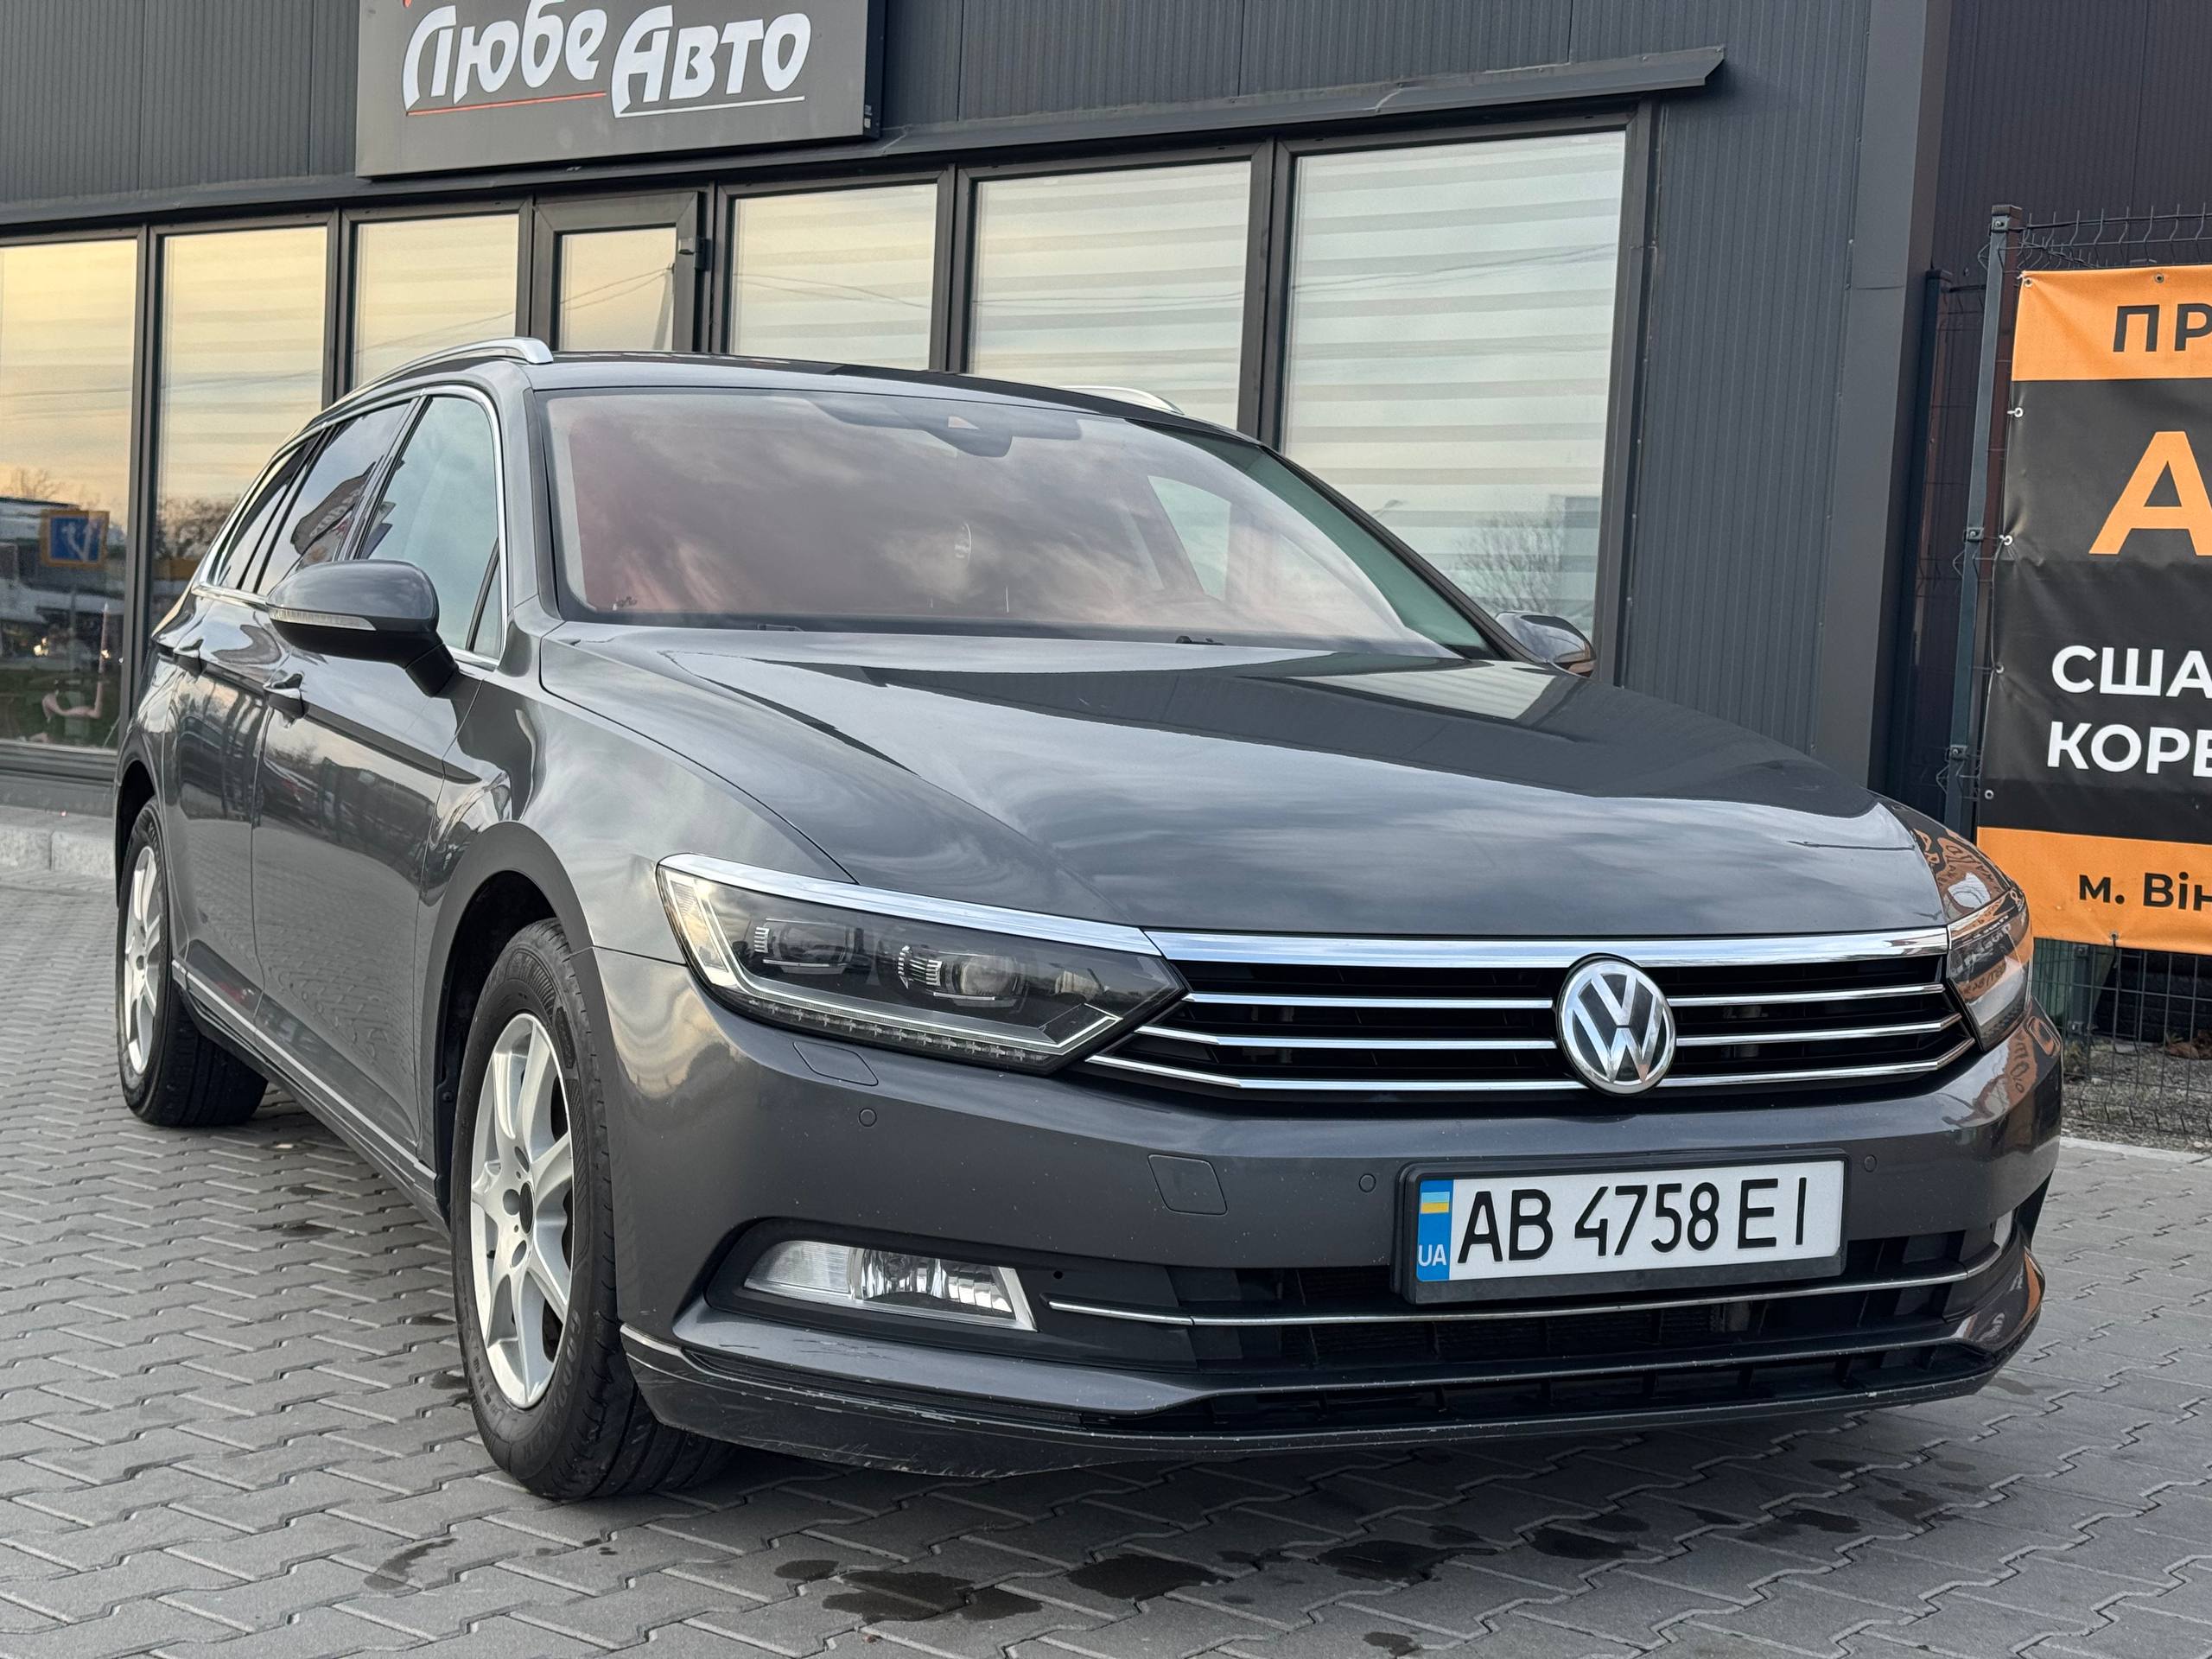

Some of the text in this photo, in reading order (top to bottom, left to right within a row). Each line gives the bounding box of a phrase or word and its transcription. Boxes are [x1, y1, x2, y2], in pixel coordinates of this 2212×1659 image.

[403, 0, 811, 118] Любе Авто
[2113, 302, 2212, 353] ПР
[2088, 430, 2212, 556] А
[2051, 645, 2212, 699] США
[1418, 1244, 1447, 1267] UA
[1458, 1188, 1554, 1264] AB
[1573, 1182, 1720, 1257] 4758
